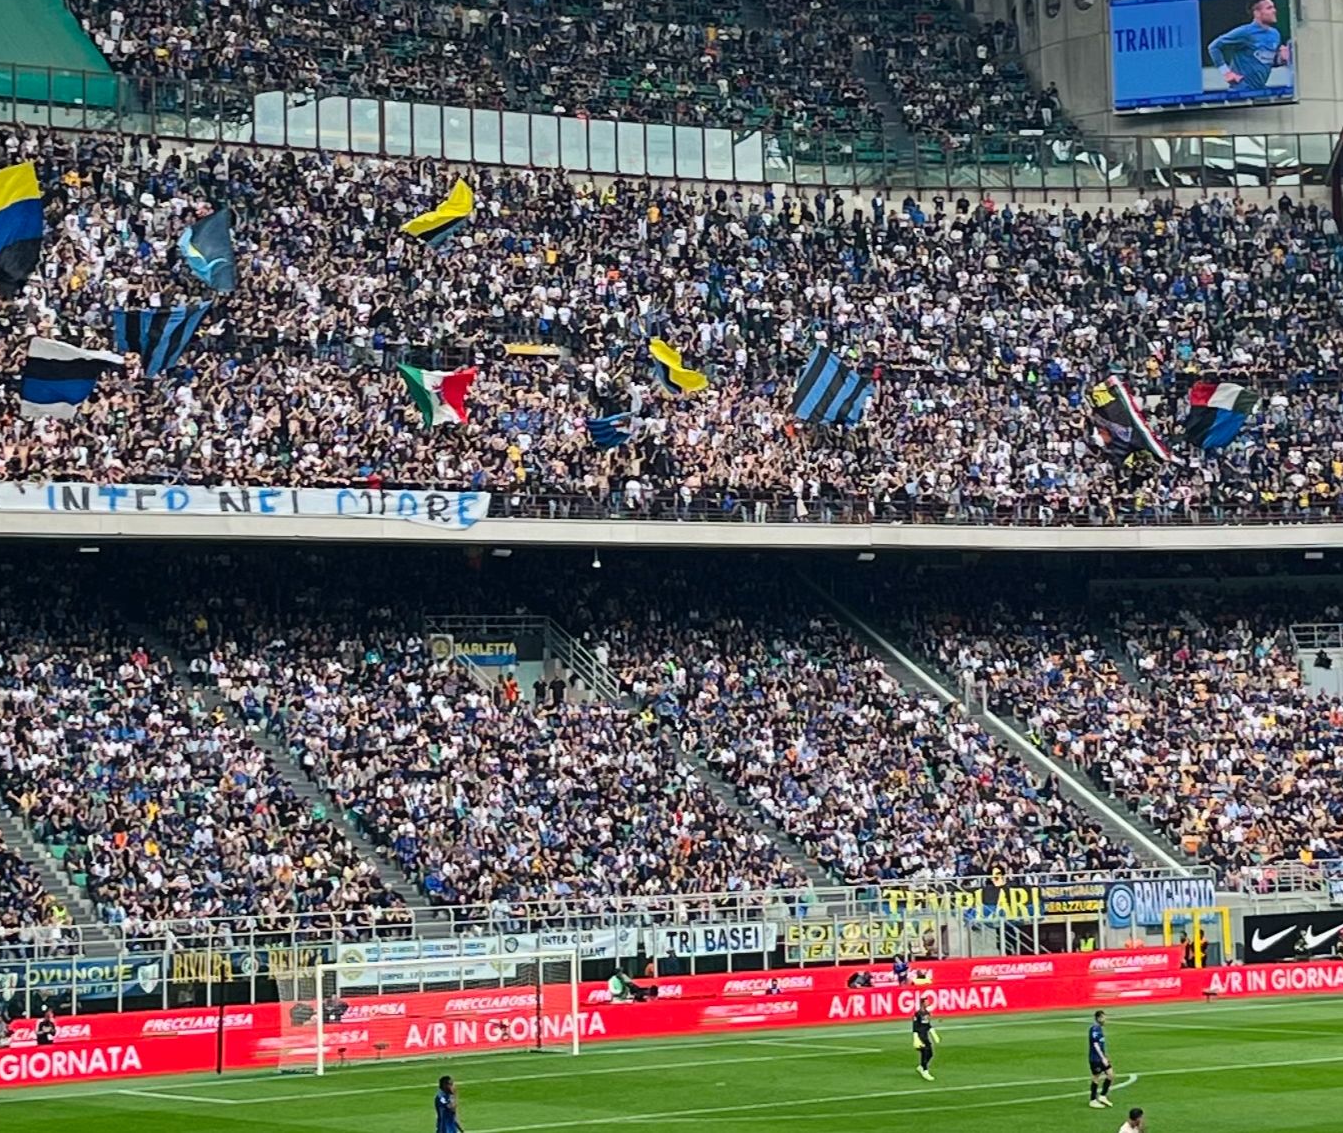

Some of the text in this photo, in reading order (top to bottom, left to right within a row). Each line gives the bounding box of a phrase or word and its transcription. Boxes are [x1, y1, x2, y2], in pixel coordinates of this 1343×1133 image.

[454, 642, 517, 656] BARLETTA
[972, 961, 1054, 976] FRECCIAROSSA
[1088, 953, 1169, 969] FRECCIAROSSA
[723, 976, 813, 992] FRECCIAOSSA
[1210, 971, 1246, 993] A/R
[1251, 970, 1268, 991] IN
[829, 986, 1007, 1019] A/R IN GIORNATA
[406, 1021, 447, 1048] A/R
[454, 1020, 478, 1044] IN
